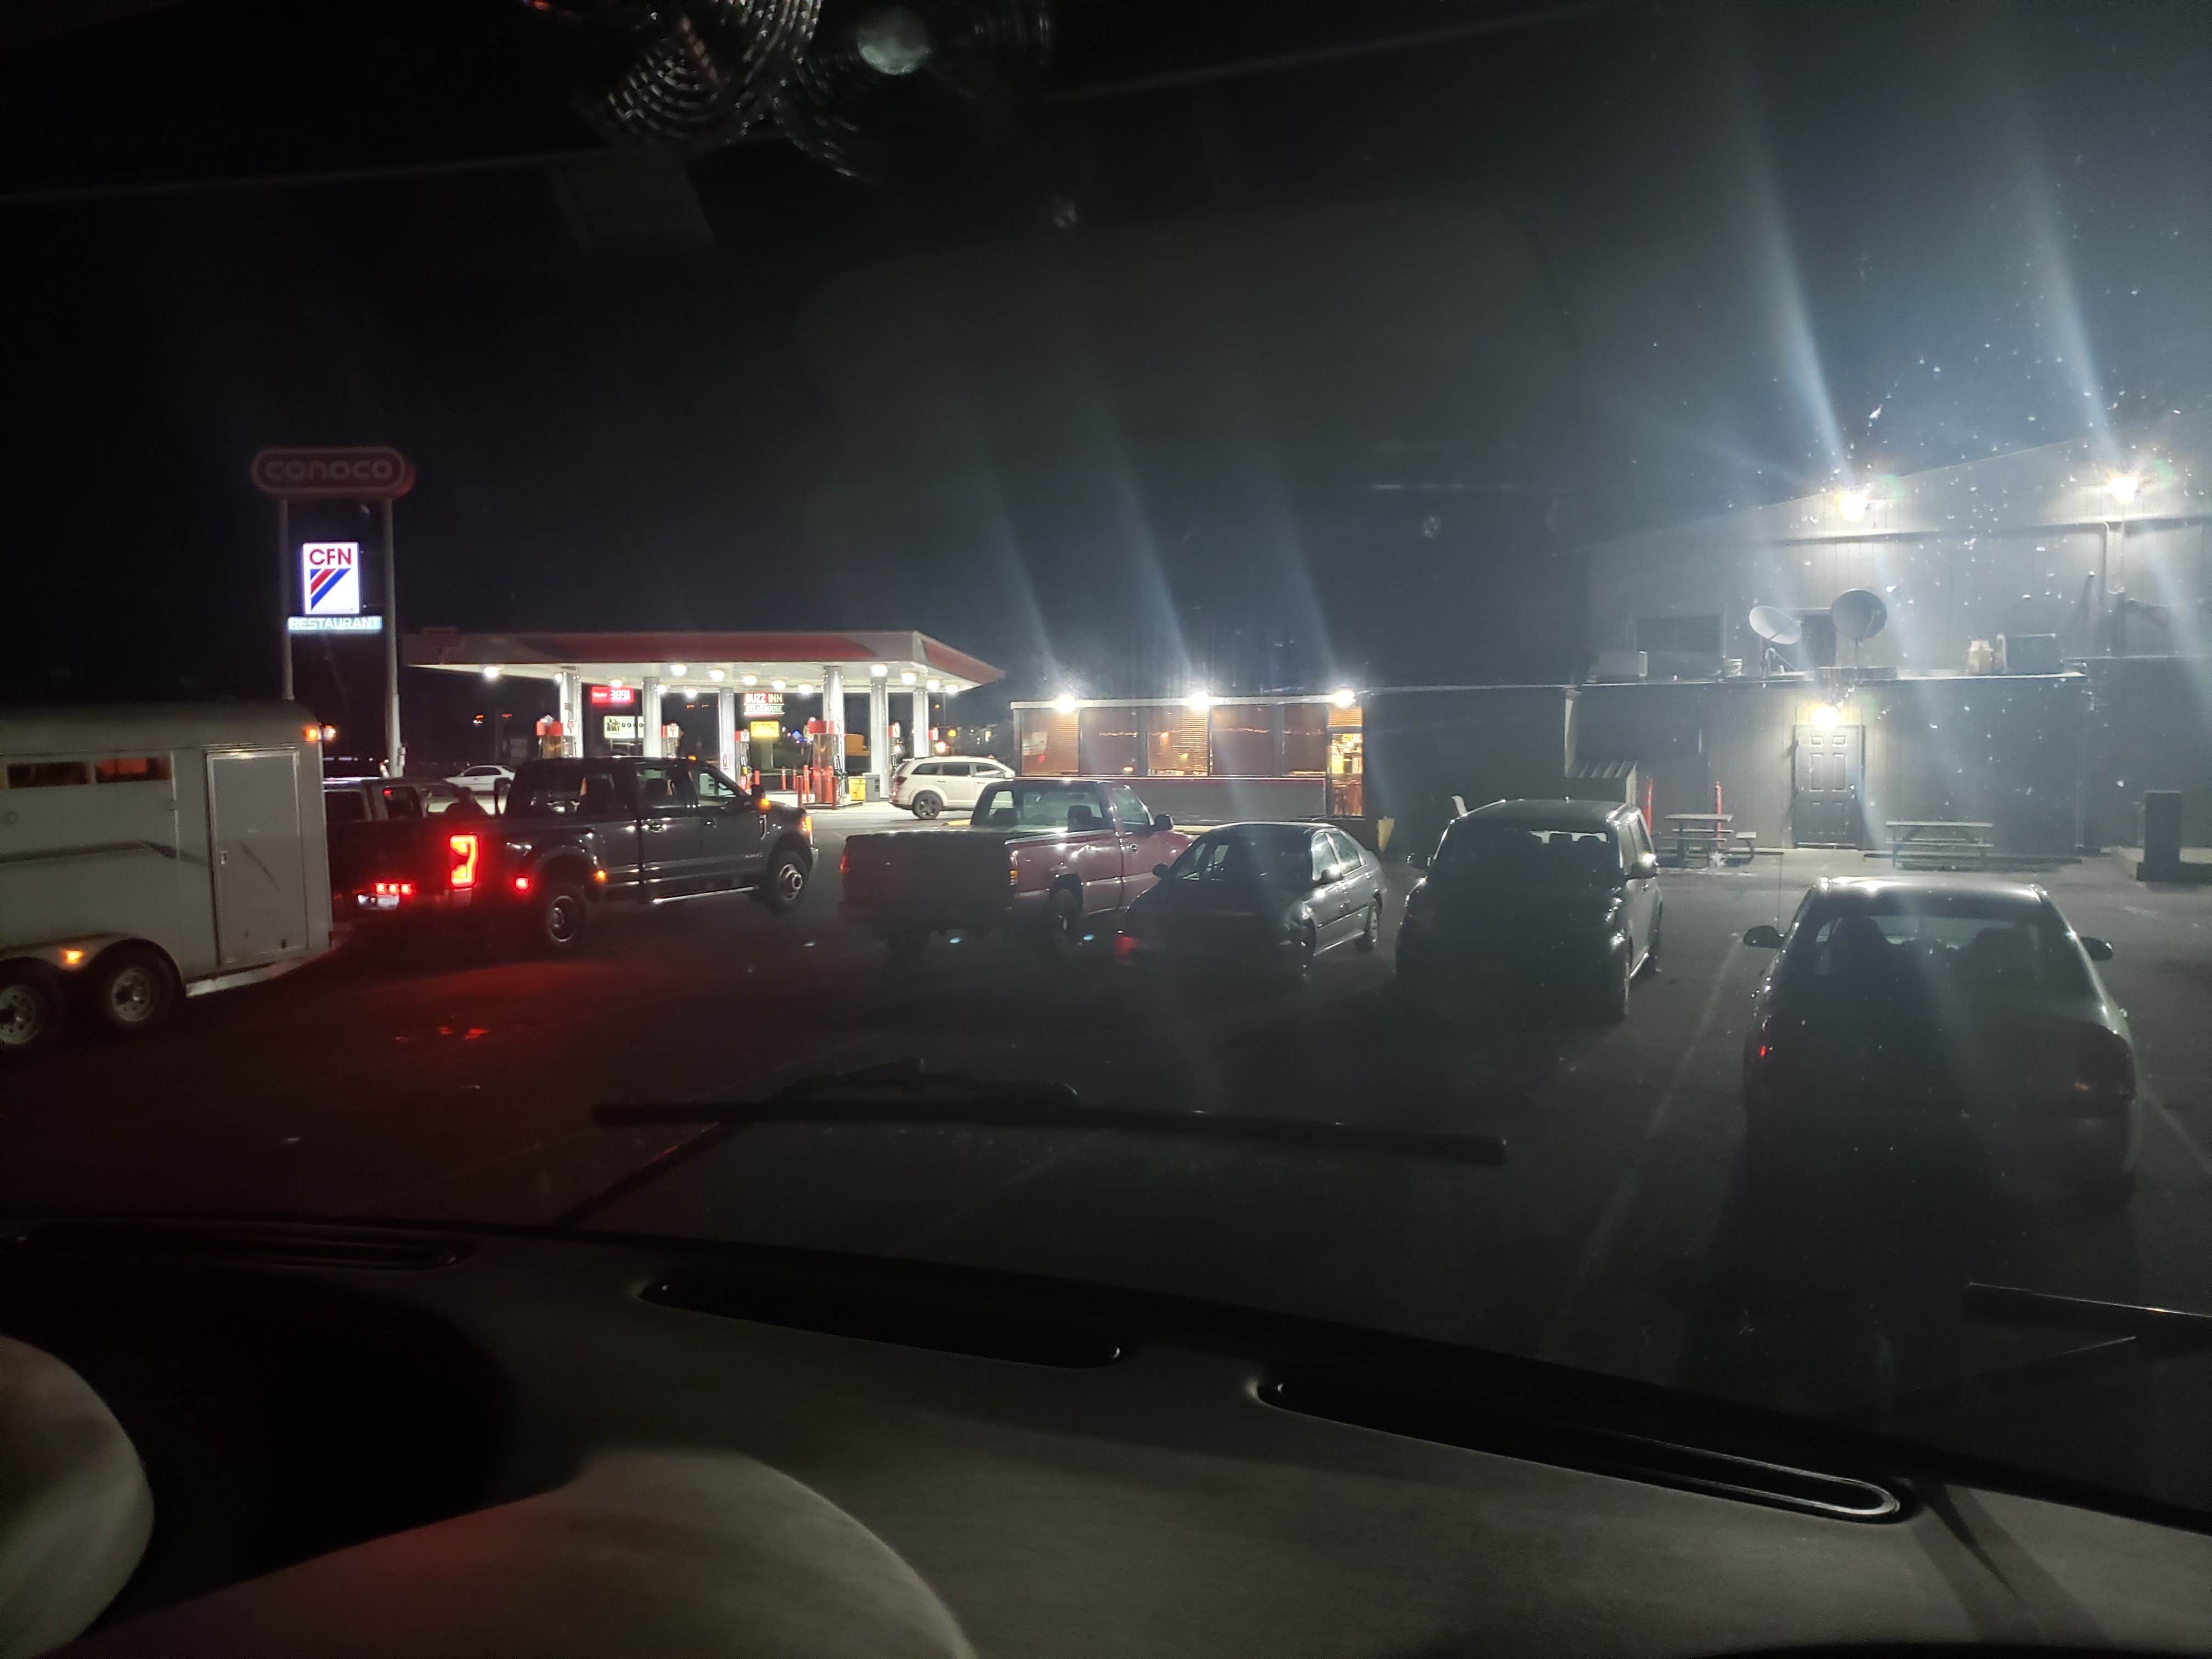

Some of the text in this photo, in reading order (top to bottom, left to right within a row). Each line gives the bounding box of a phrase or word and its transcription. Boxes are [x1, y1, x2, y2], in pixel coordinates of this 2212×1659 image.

[310, 548, 352, 566] CFN
[290, 618, 380, 629] RESTAURANT
[768, 693, 782, 703] INN
